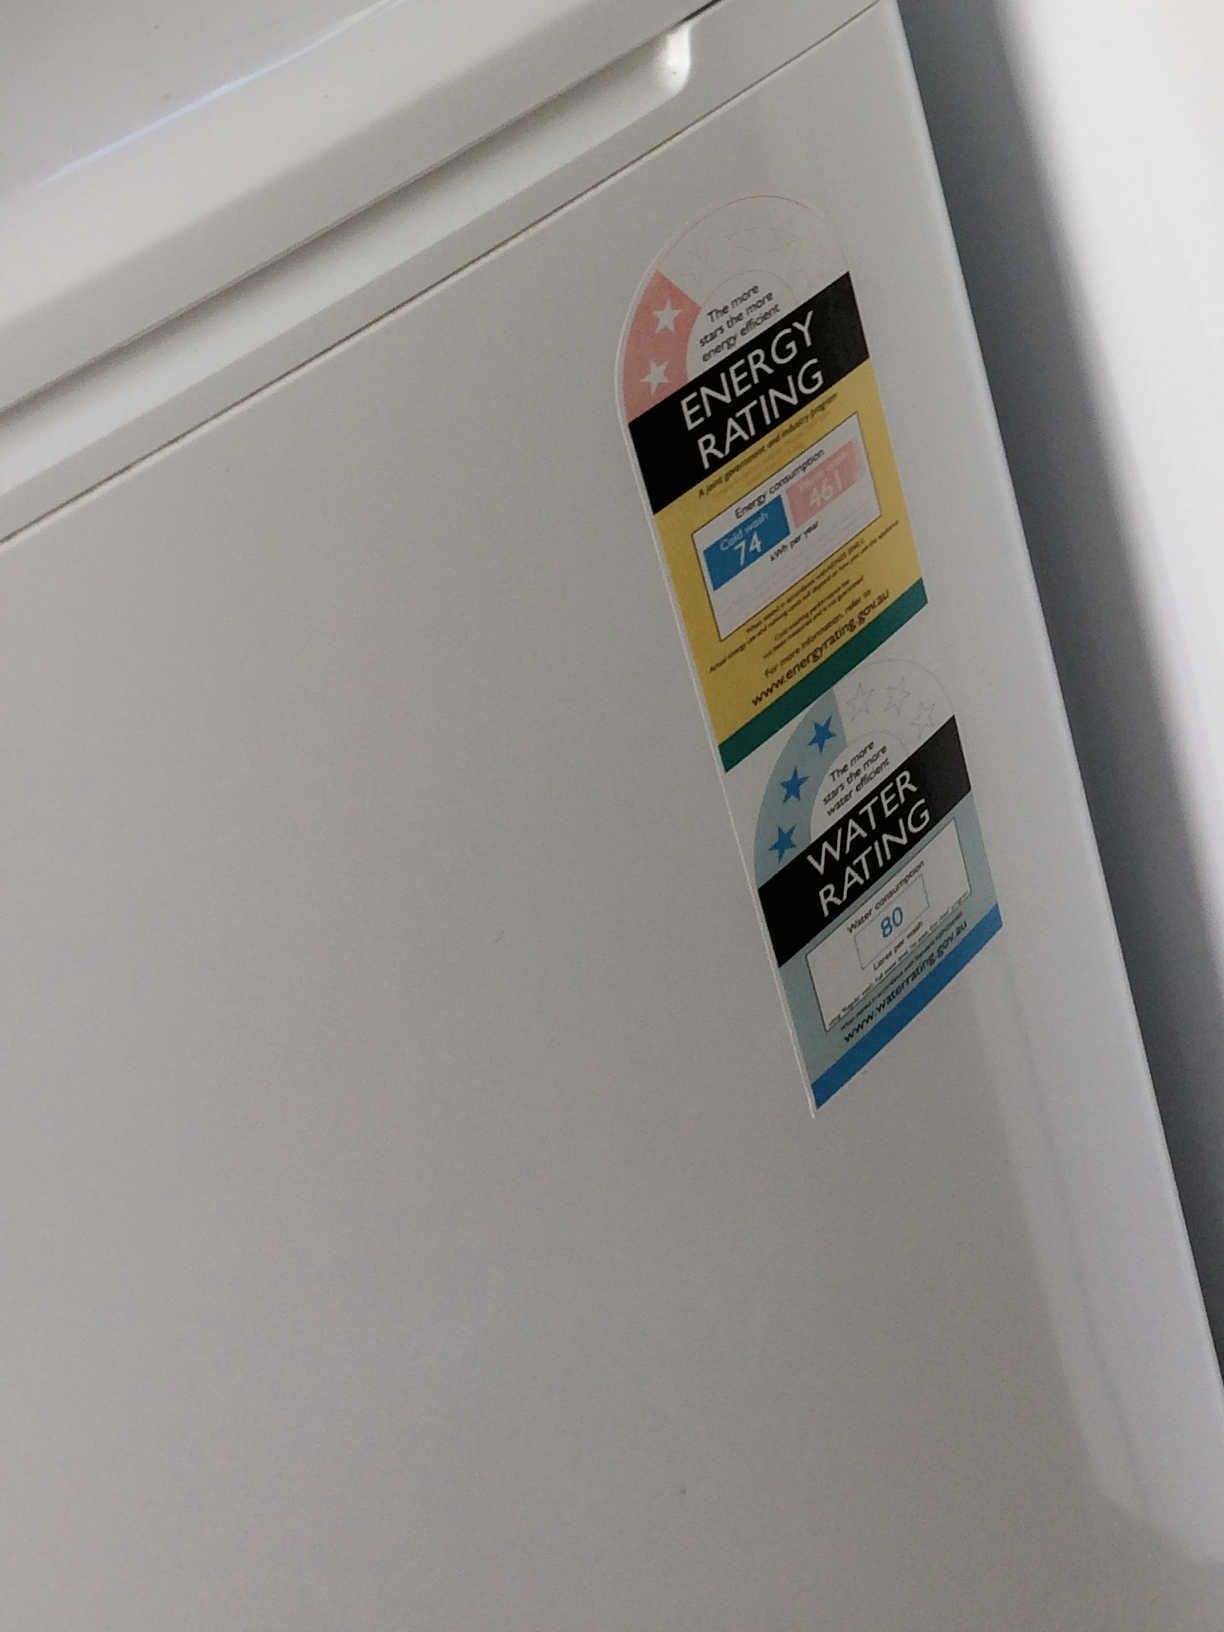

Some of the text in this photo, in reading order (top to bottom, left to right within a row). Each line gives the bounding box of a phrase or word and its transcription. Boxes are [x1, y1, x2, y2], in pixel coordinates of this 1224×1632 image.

[699, 292, 773, 347] stars the more
[702, 303, 780, 362] energy efficient
[706, 285, 759, 323] The more
[680, 310, 815, 431] ENERGY
[697, 358, 825, 470] RATING
[734, 492, 767, 519] Energy
[769, 449, 825, 495] consumption
[719, 511, 769, 551] Cold wash
[734, 531, 762, 567] 74
[789, 536, 802, 550] per
[803, 520, 819, 539] year
[752, 589, 890, 706] www.energyrating.gov.au
[823, 745, 887, 805] stars the more
[826, 757, 890, 817] water efficient
[830, 740, 874, 782] The more
[807, 769, 920, 876] WATER
[817, 797, 931, 918] RATING
[847, 860, 925, 934] Water consumption
[880, 906, 904, 939] 80
[844, 920, 968, 1043] www.waterrating.gov.au
